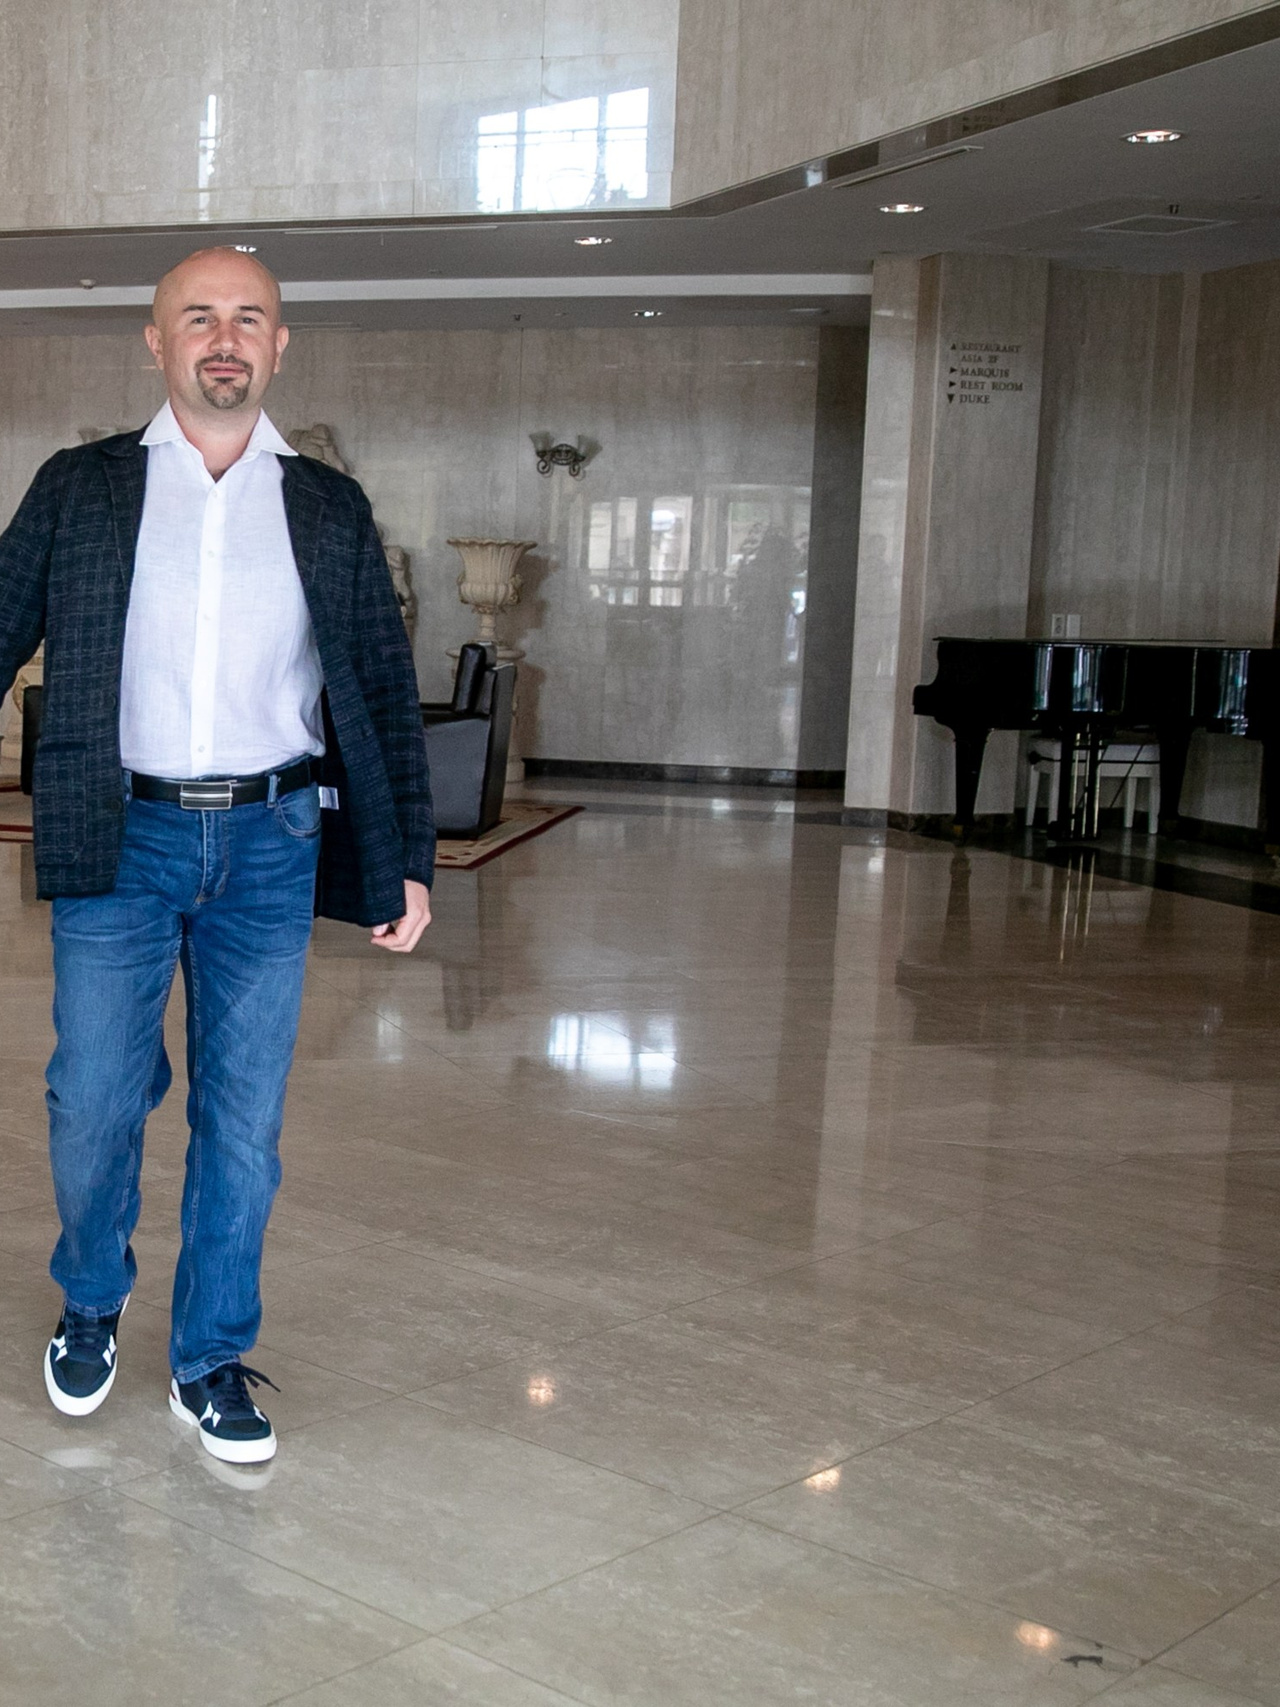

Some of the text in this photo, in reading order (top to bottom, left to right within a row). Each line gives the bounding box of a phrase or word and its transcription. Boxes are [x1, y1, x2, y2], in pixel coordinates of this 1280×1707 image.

[960, 343, 1021, 353] RESTAURANT
[960, 368, 1010, 378] MARQUIS
[960, 380, 1023, 391] REST ROOM
[959, 394, 990, 404] DUKE
